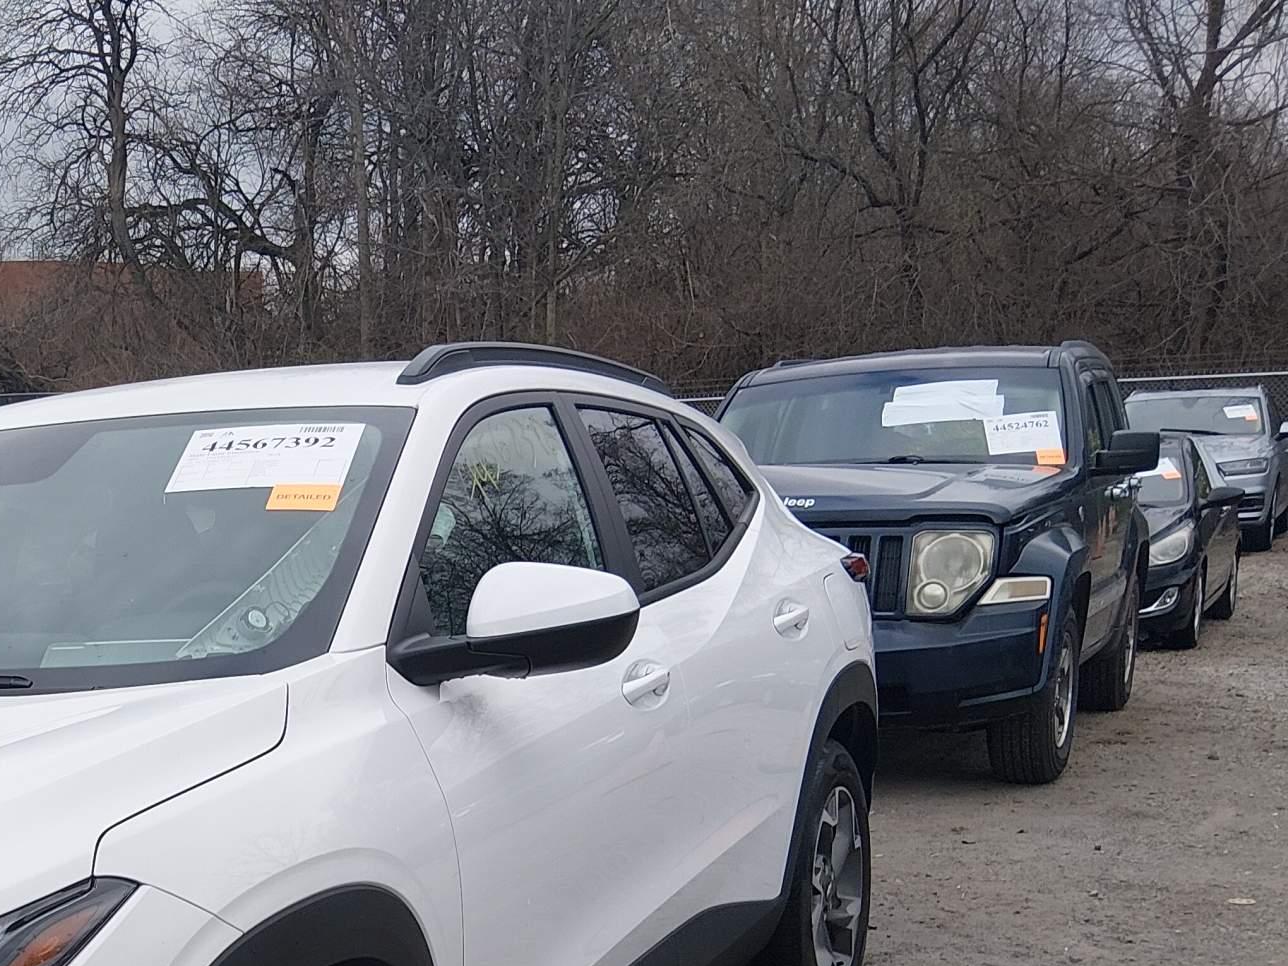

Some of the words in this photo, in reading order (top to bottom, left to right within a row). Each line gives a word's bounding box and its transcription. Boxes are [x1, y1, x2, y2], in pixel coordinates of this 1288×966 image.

[993, 419, 1049, 432] 44524762
[201, 436, 337, 453] 44567392
[276, 493, 332, 501] DETAILED
